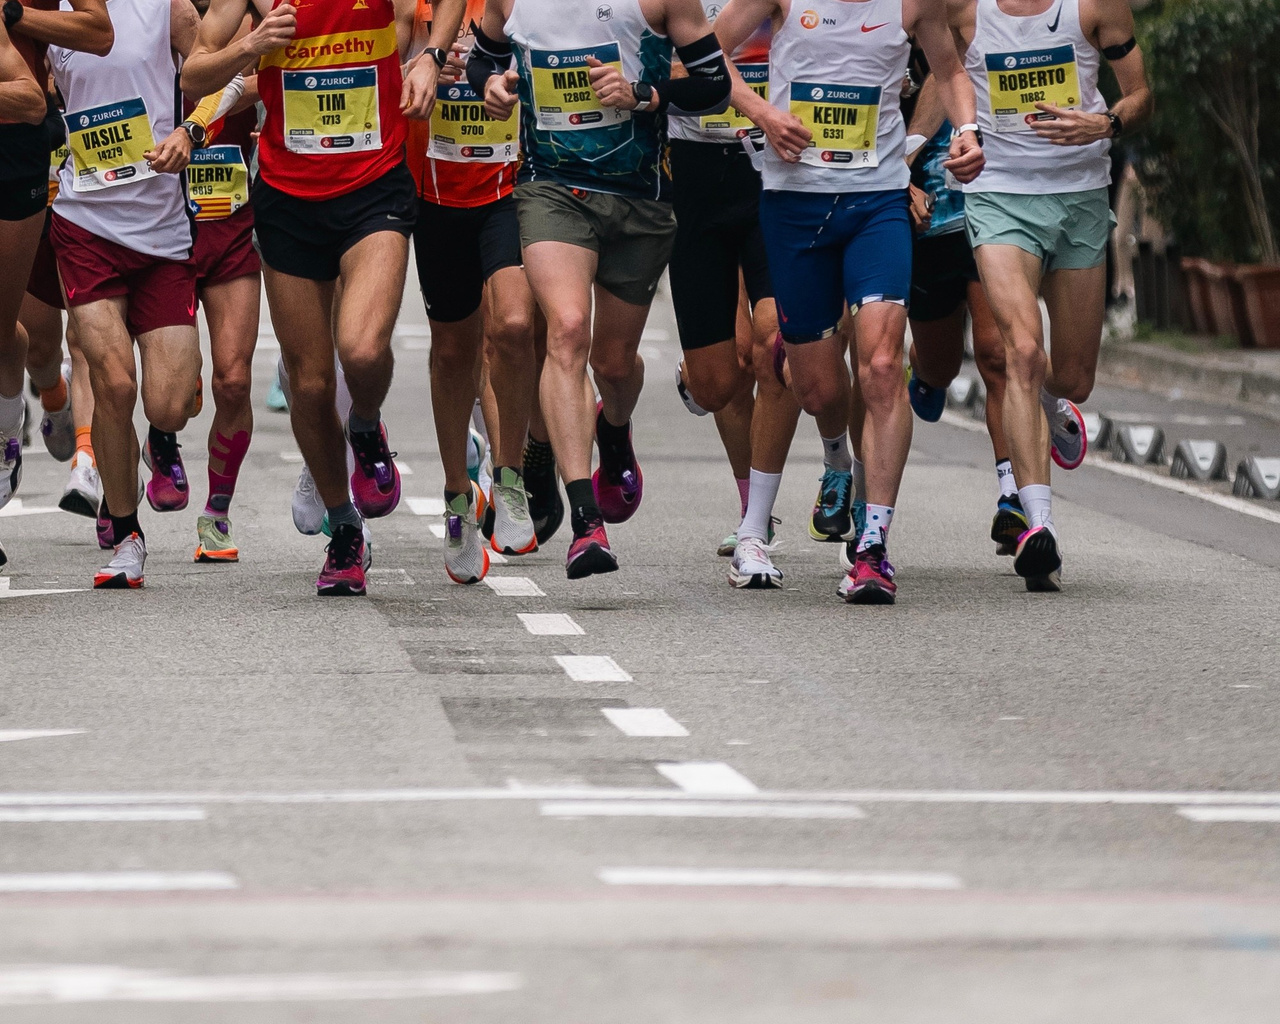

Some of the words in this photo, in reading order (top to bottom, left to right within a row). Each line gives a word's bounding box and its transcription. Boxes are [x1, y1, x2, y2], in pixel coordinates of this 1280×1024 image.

[822, 18, 836, 26] NN
[284, 37, 375, 59] Carnethy
[1020, 54, 1052, 65] ZURICH
[320, 77, 354, 86] ZURICH
[552, 70, 591, 90] MAR
[998, 67, 1066, 92] ROBERTO
[562, 91, 591, 103] 12802
[826, 90, 860, 100] ZURICH
[1020, 90, 1046, 104] 11882
[317, 93, 346, 112] TIM
[92, 108, 124, 122] ZURICH
[322, 114, 341, 126] 1713
[441, 104, 495, 122] ANTON
[813, 106, 858, 126] KEVIN
[82, 123, 133, 150] VASILE
[460, 126, 484, 136] 9700
[823, 128, 844, 140] 6331
[97, 146, 123, 162] 14279
[194, 153, 225, 161] ZURICH
